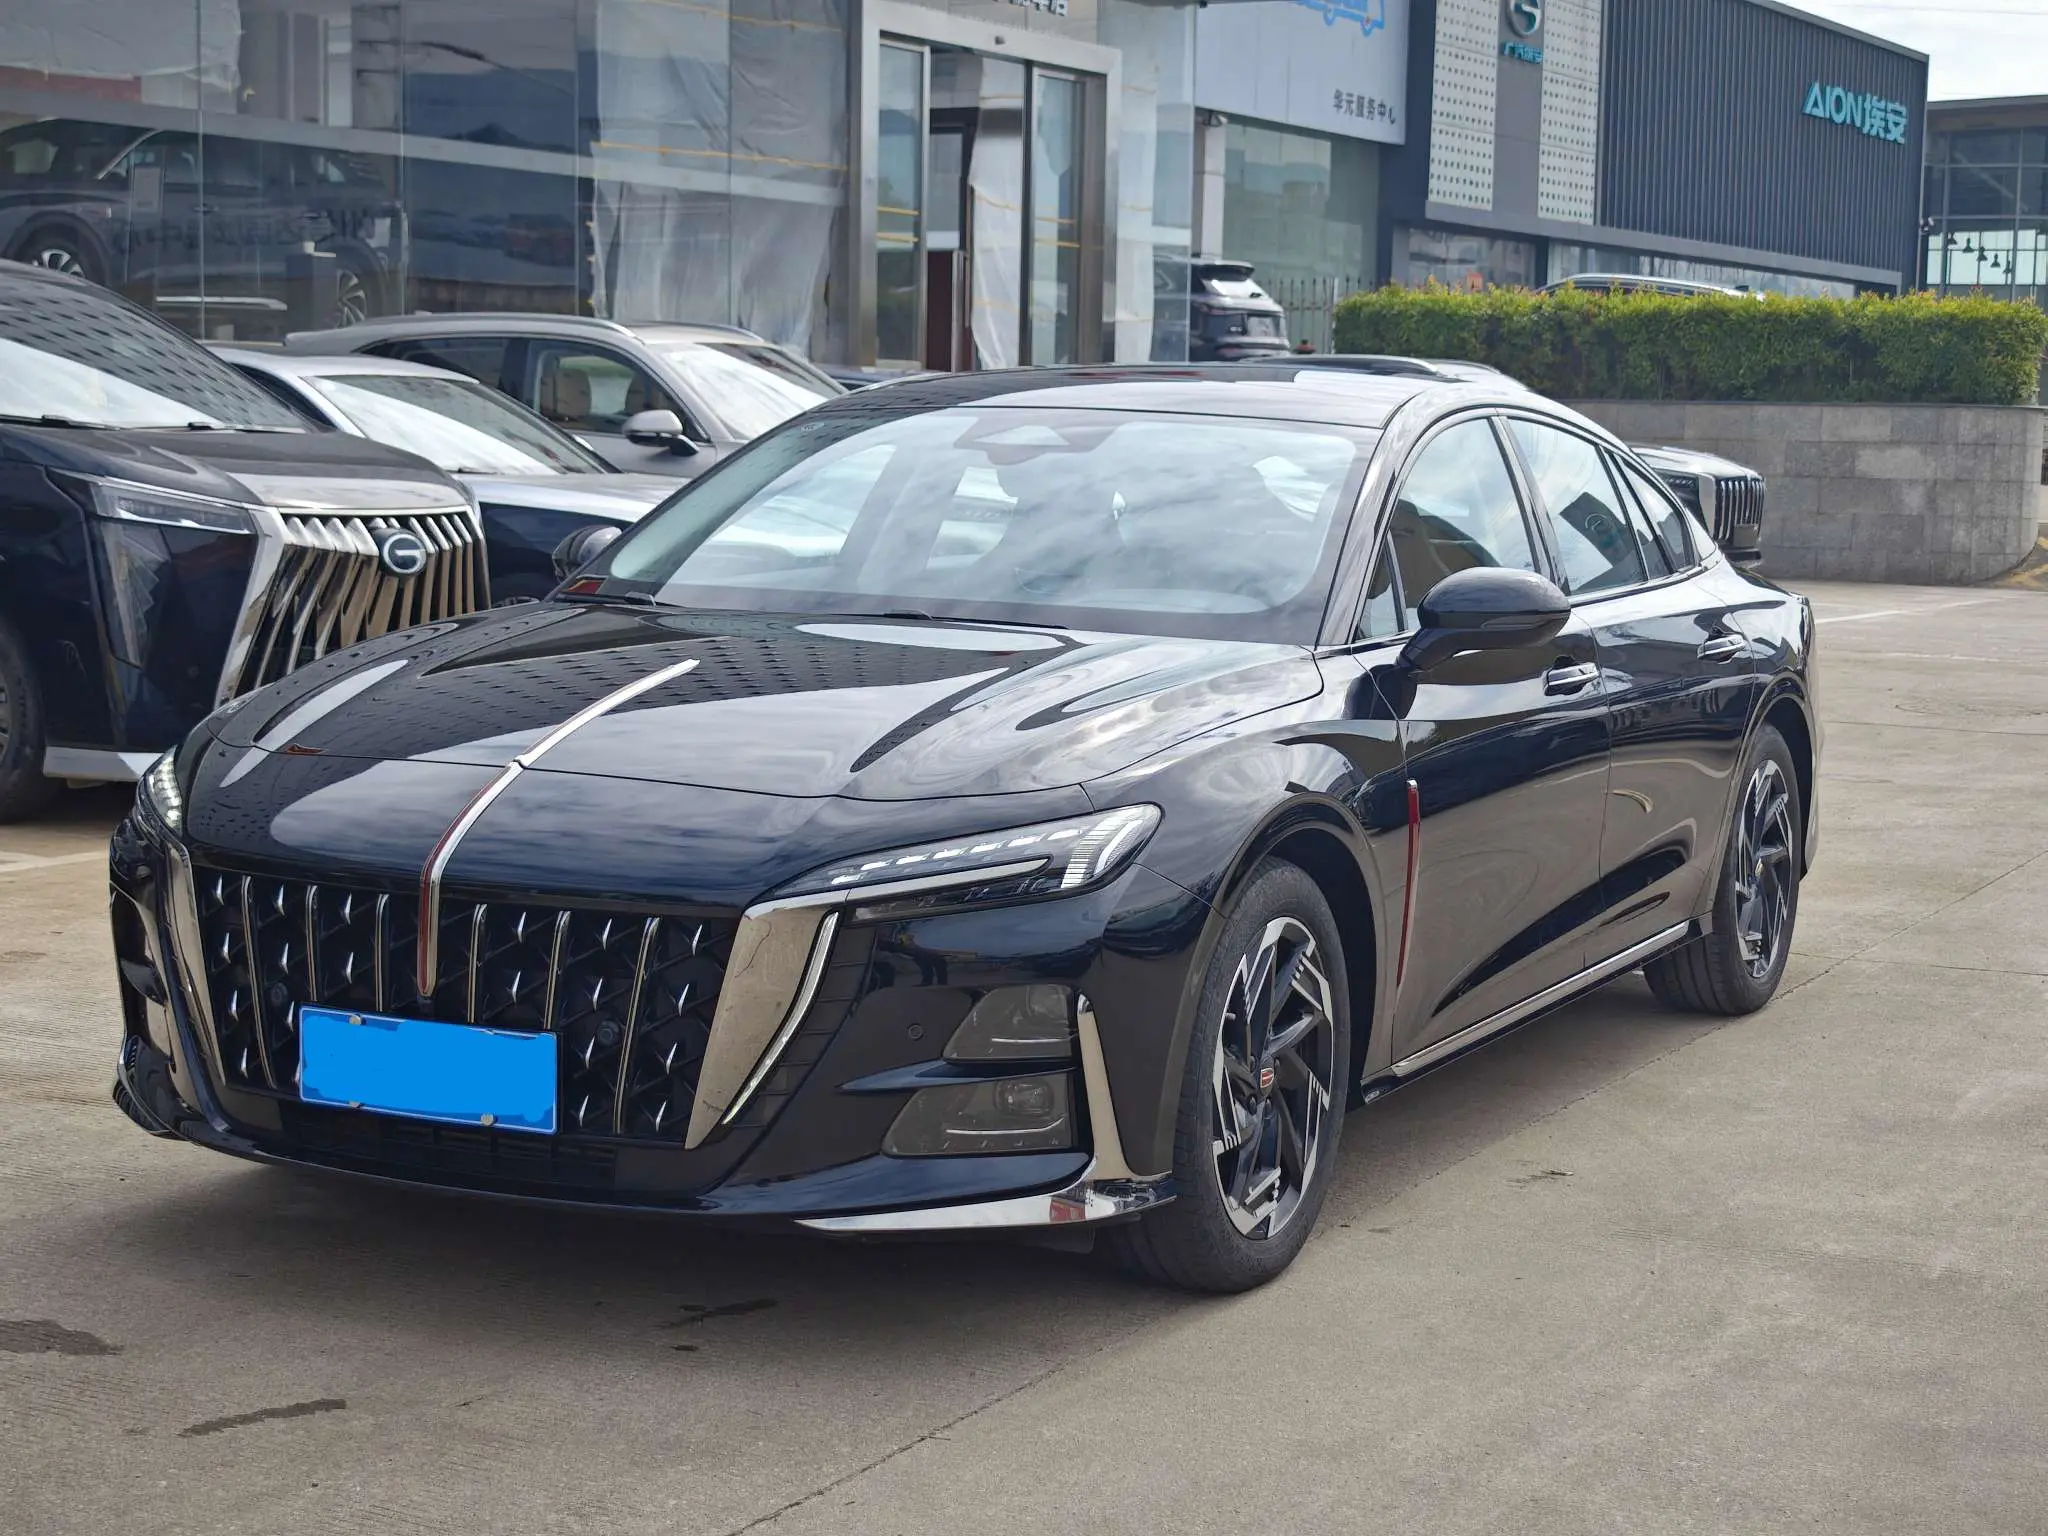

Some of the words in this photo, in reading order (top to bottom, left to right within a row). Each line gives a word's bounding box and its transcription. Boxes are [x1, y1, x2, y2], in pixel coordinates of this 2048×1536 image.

[1333, 89, 1395, 124] 华元服务中心
